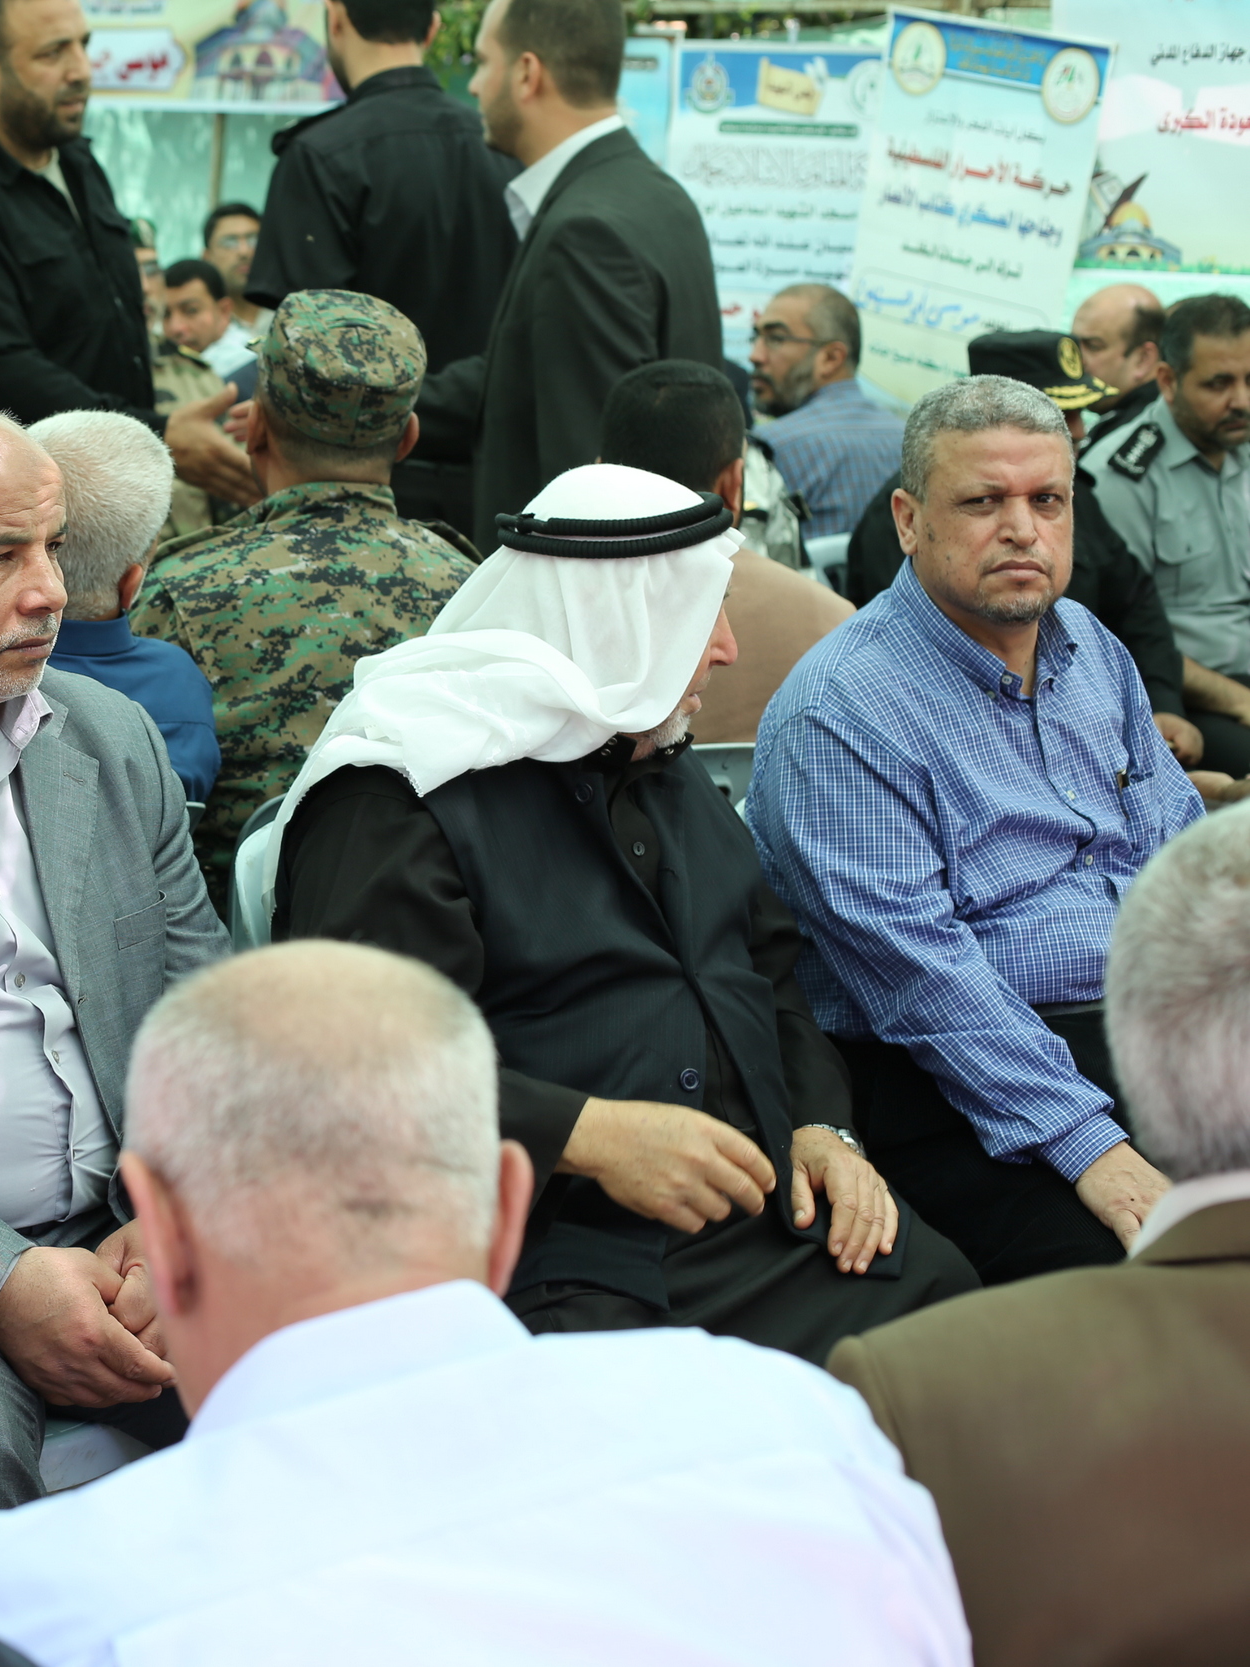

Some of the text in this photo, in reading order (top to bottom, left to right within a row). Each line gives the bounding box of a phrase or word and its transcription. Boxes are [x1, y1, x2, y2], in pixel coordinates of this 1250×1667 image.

[1157, 108, 1216, 138] الكبرى
[887, 134, 949, 171] الفلسطينية
[1014, 163, 1071, 199] حركة
